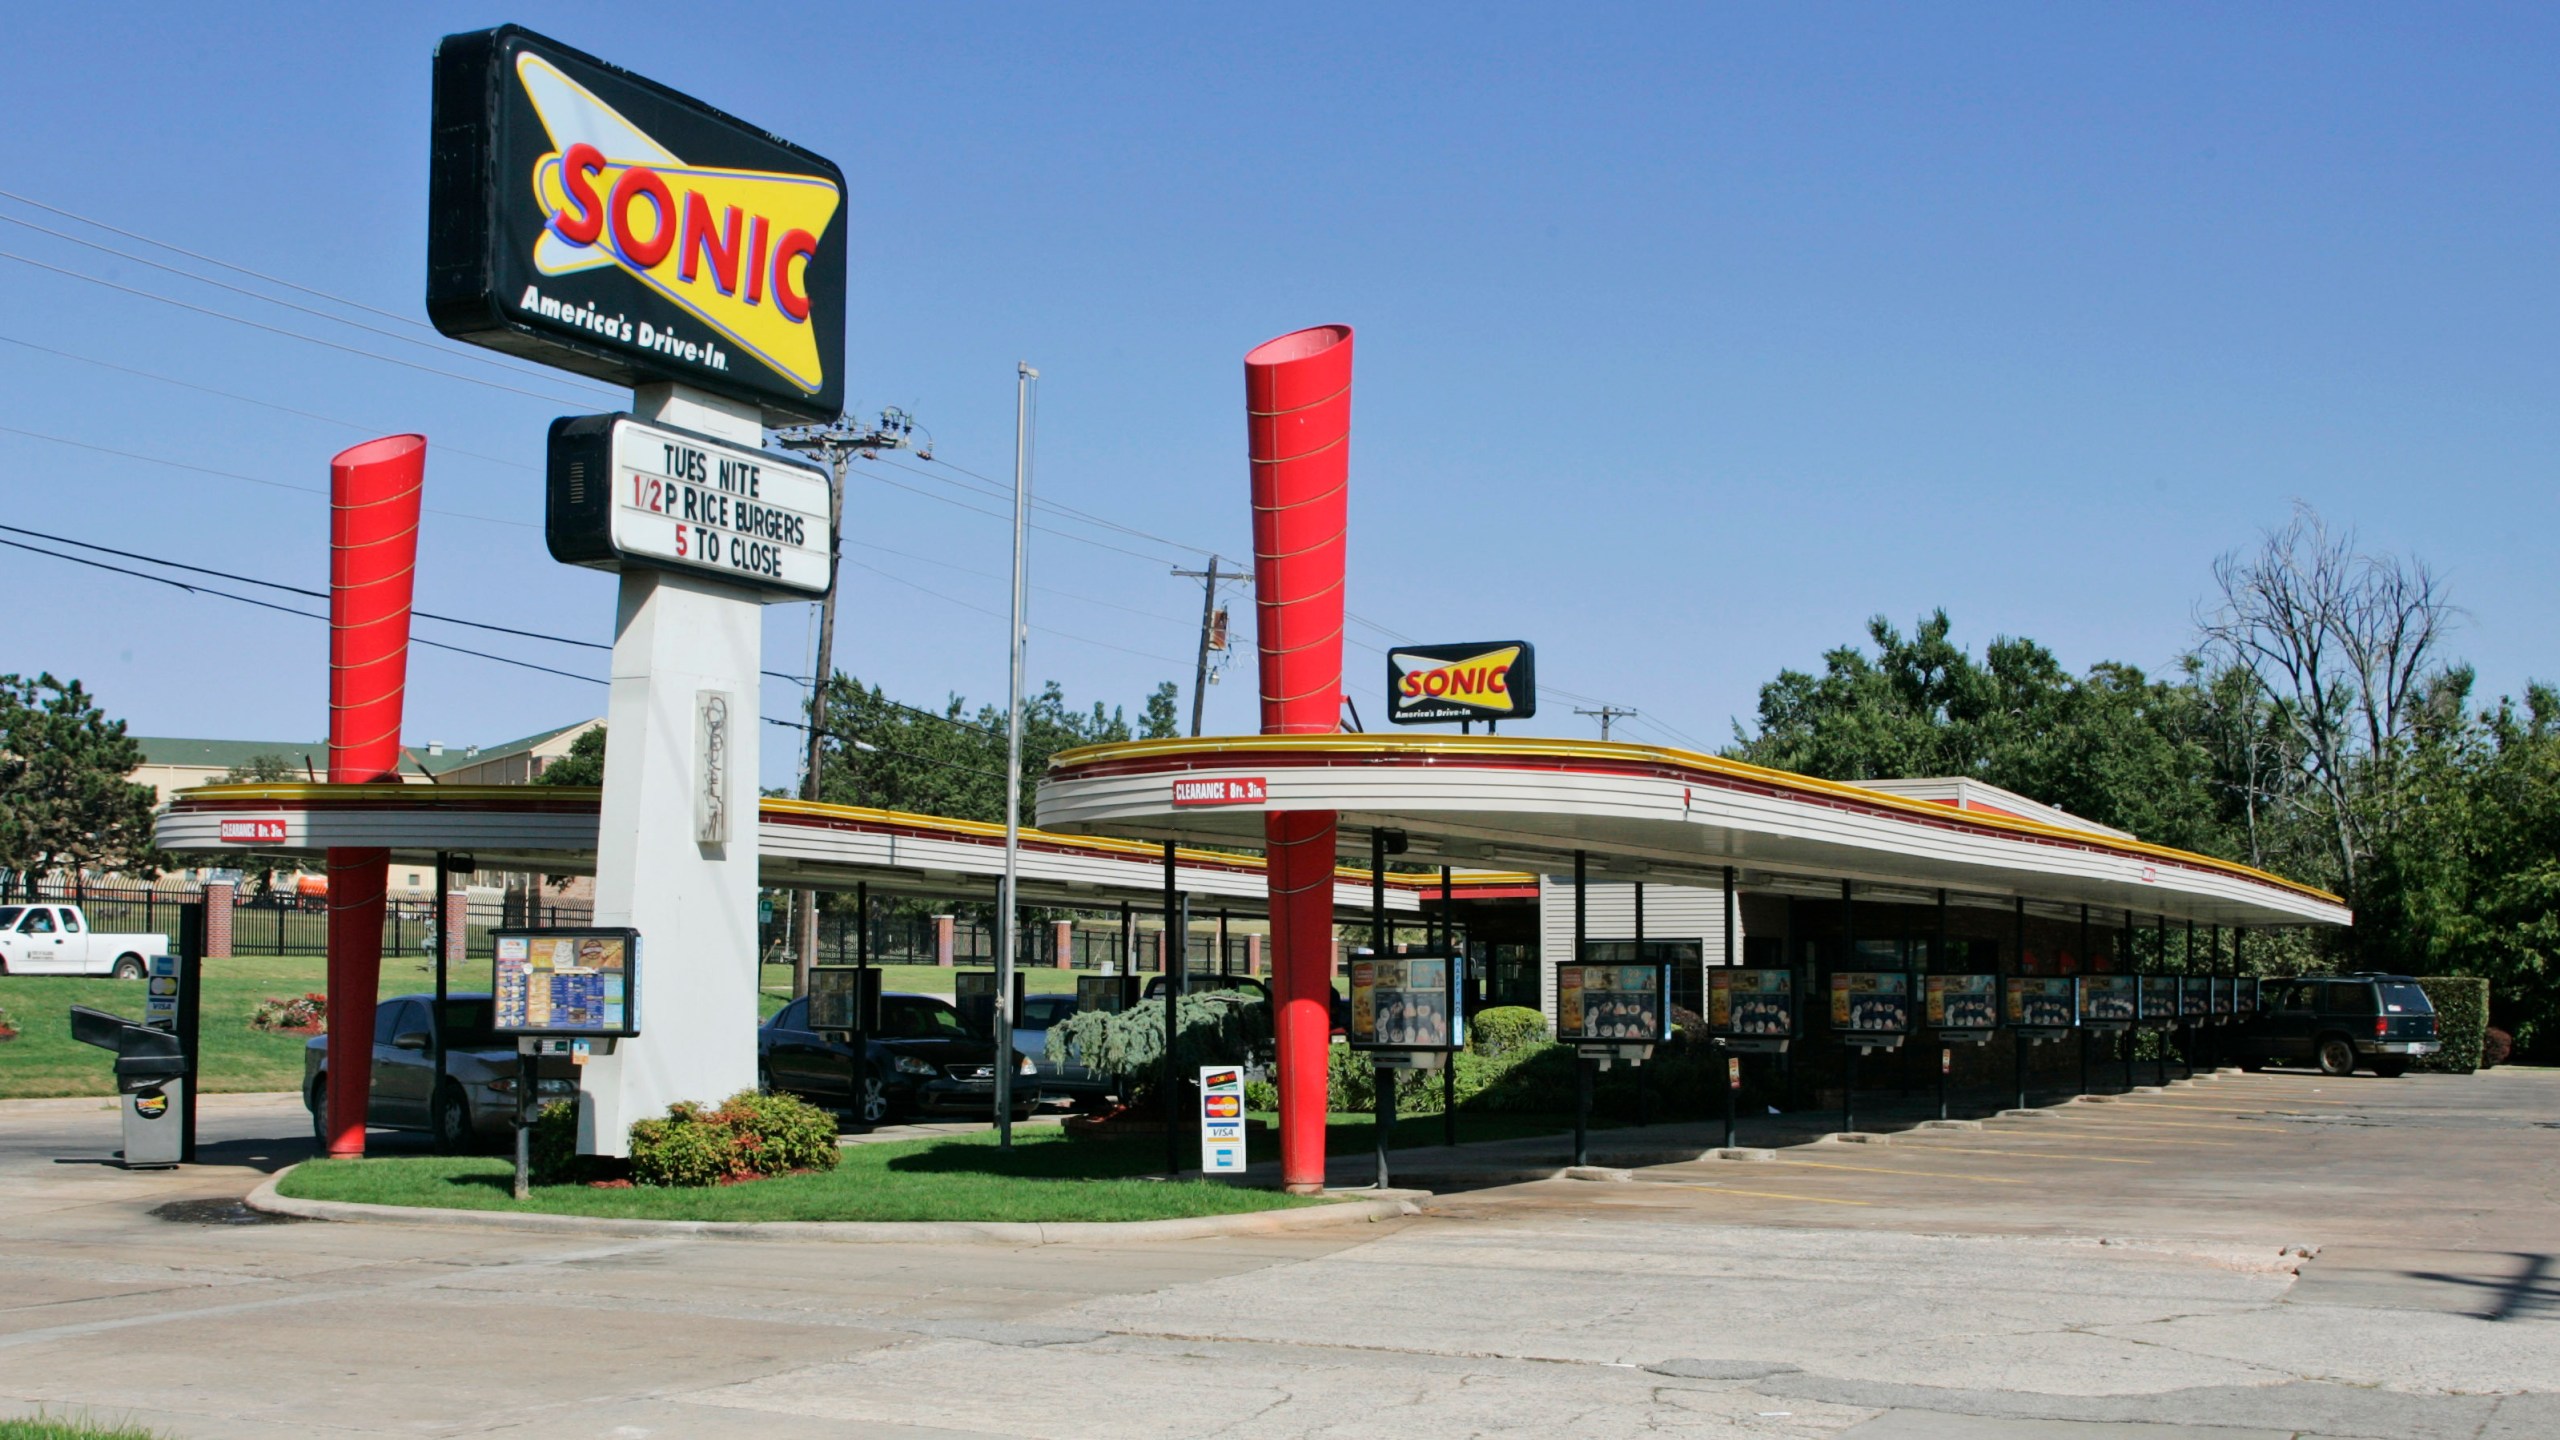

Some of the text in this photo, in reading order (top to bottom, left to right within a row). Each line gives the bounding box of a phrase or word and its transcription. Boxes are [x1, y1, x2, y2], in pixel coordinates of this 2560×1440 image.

[546, 143, 817, 323] SONIC
[520, 285, 727, 370] America's Drive-In
[664, 444, 760, 498] TUES NITE
[665, 483, 728, 527] PRICE
[735, 502, 804, 546] BURGERS
[676, 524, 782, 578] 5 TO CLOSE
[1403, 665, 1509, 698] SONIC
[1395, 708, 1471, 718] America's Drive-In
[1176, 782, 1264, 800] CLEARANCE 8ft. 3in.
[222, 823, 255, 837] CLEARANCE
[1213, 1128, 1234, 1136] VISA
